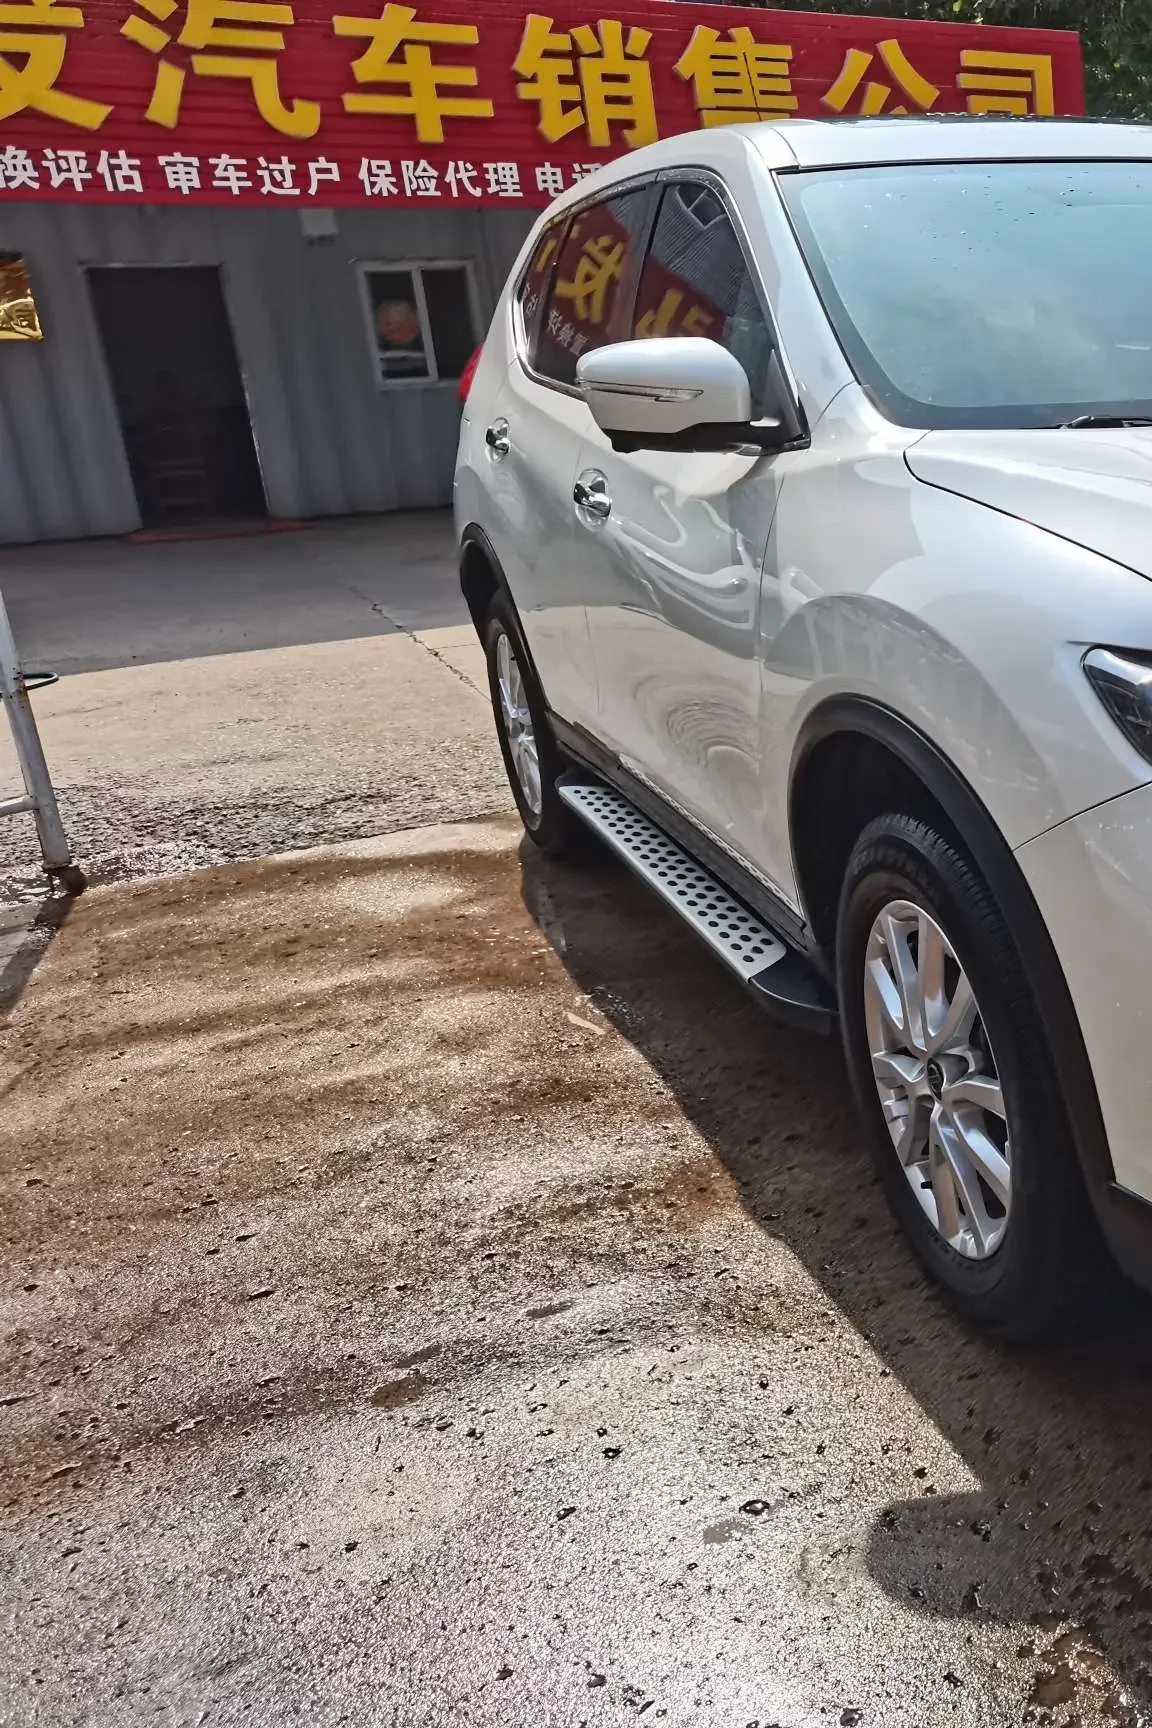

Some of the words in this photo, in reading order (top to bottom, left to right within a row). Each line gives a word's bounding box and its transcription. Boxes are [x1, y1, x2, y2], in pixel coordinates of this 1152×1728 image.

[157, 152, 341, 196] 审车过户
[358, 157, 523, 198] 保险代理
